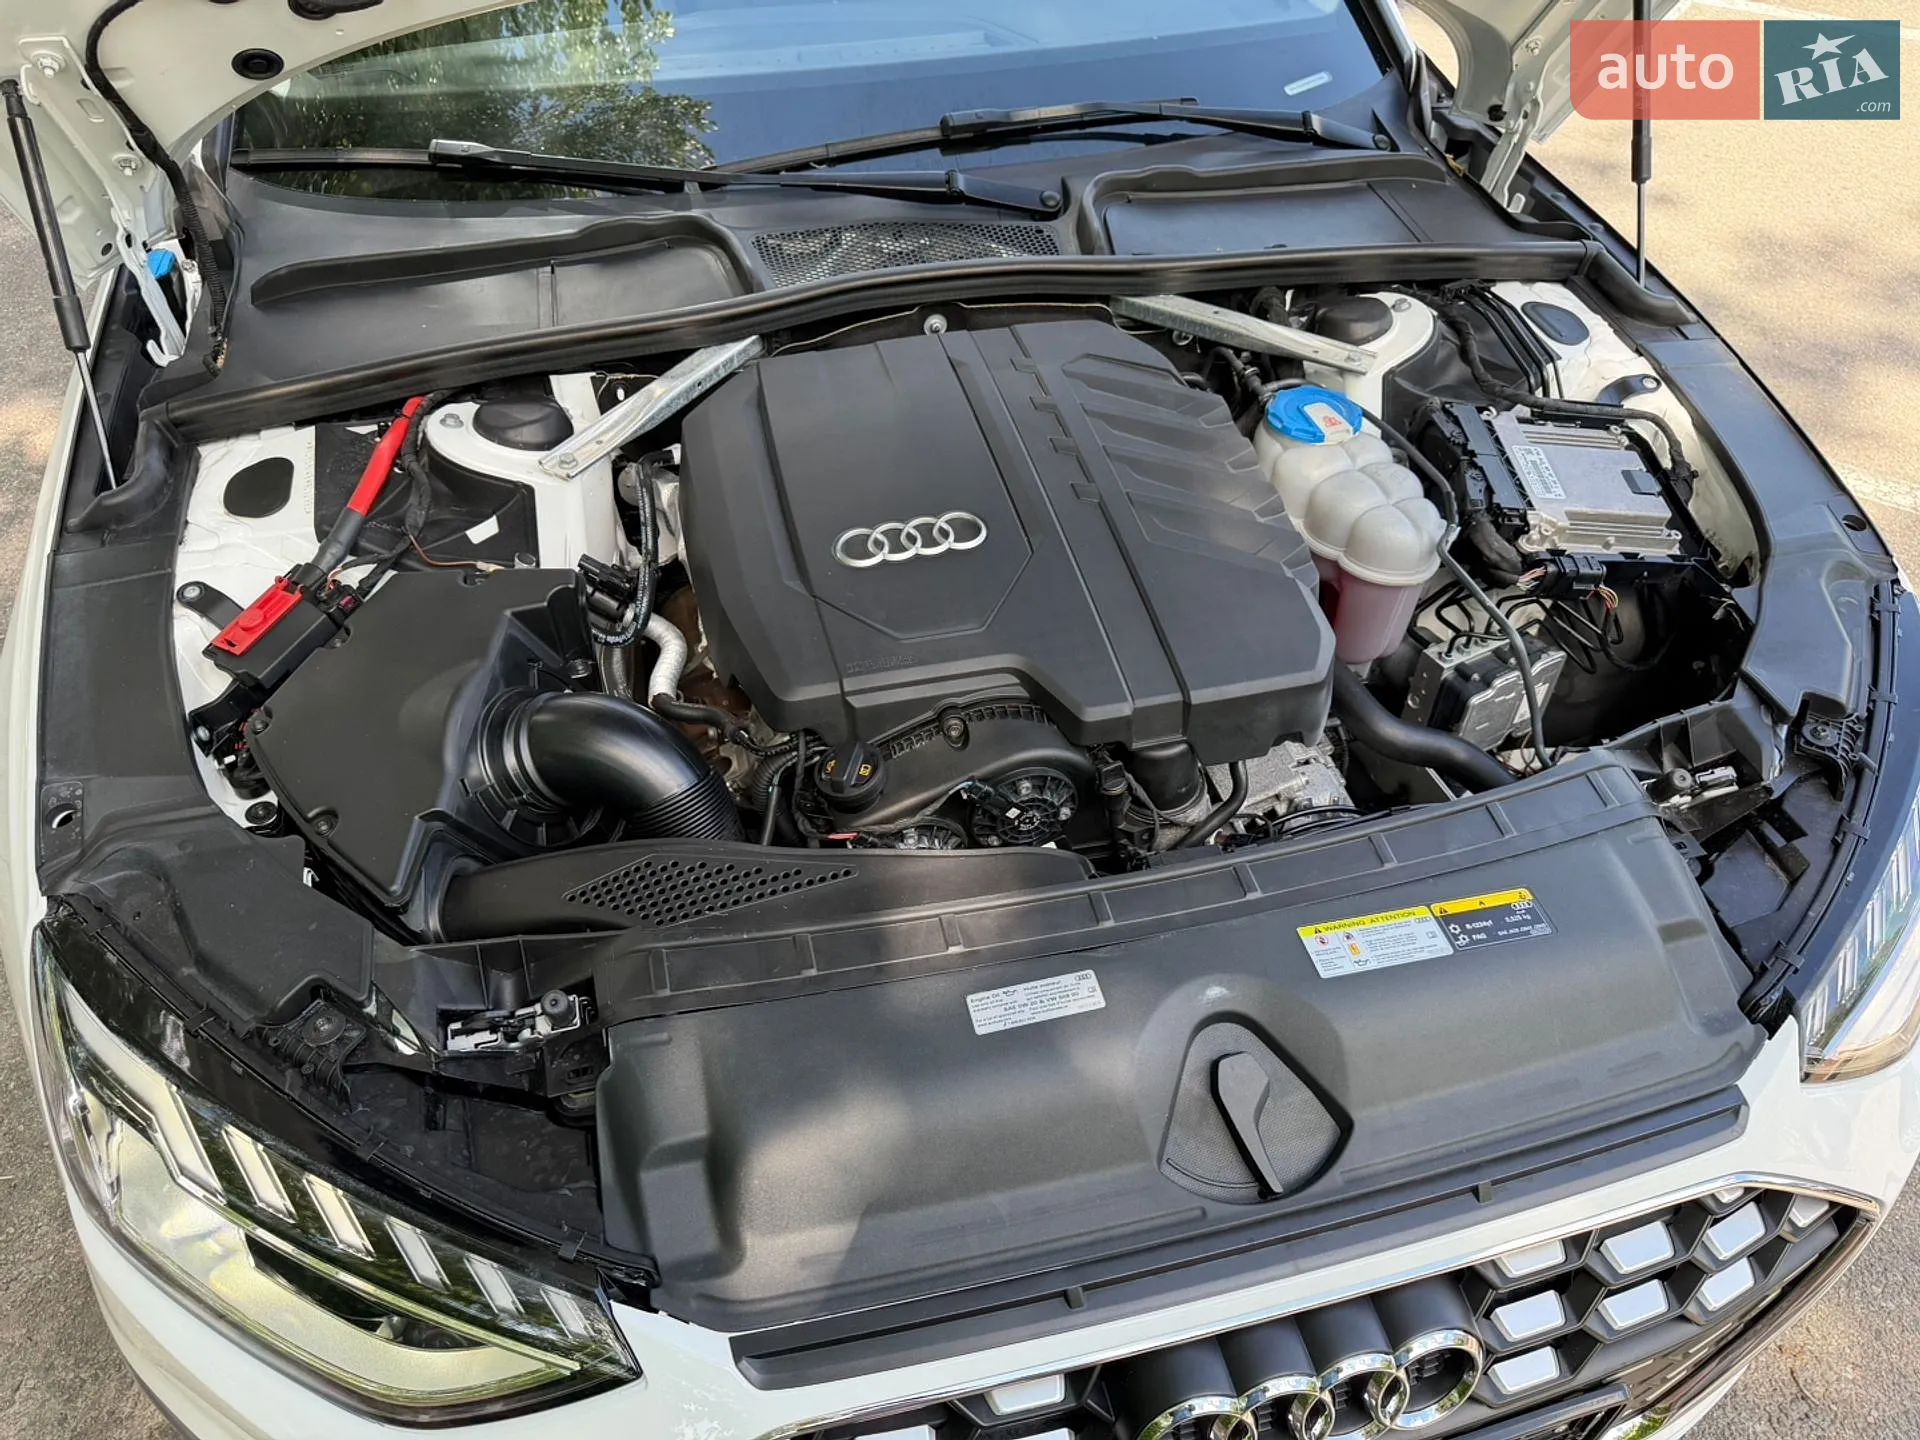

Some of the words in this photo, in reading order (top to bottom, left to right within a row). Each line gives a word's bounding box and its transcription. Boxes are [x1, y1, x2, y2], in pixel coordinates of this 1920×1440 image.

[1324, 920, 1366, 931] WARNING
[1370, 911, 1416, 924] ATTENTION
[971, 995, 990, 1004] Engine
[1004, 1004, 1017, 1012] SAE
